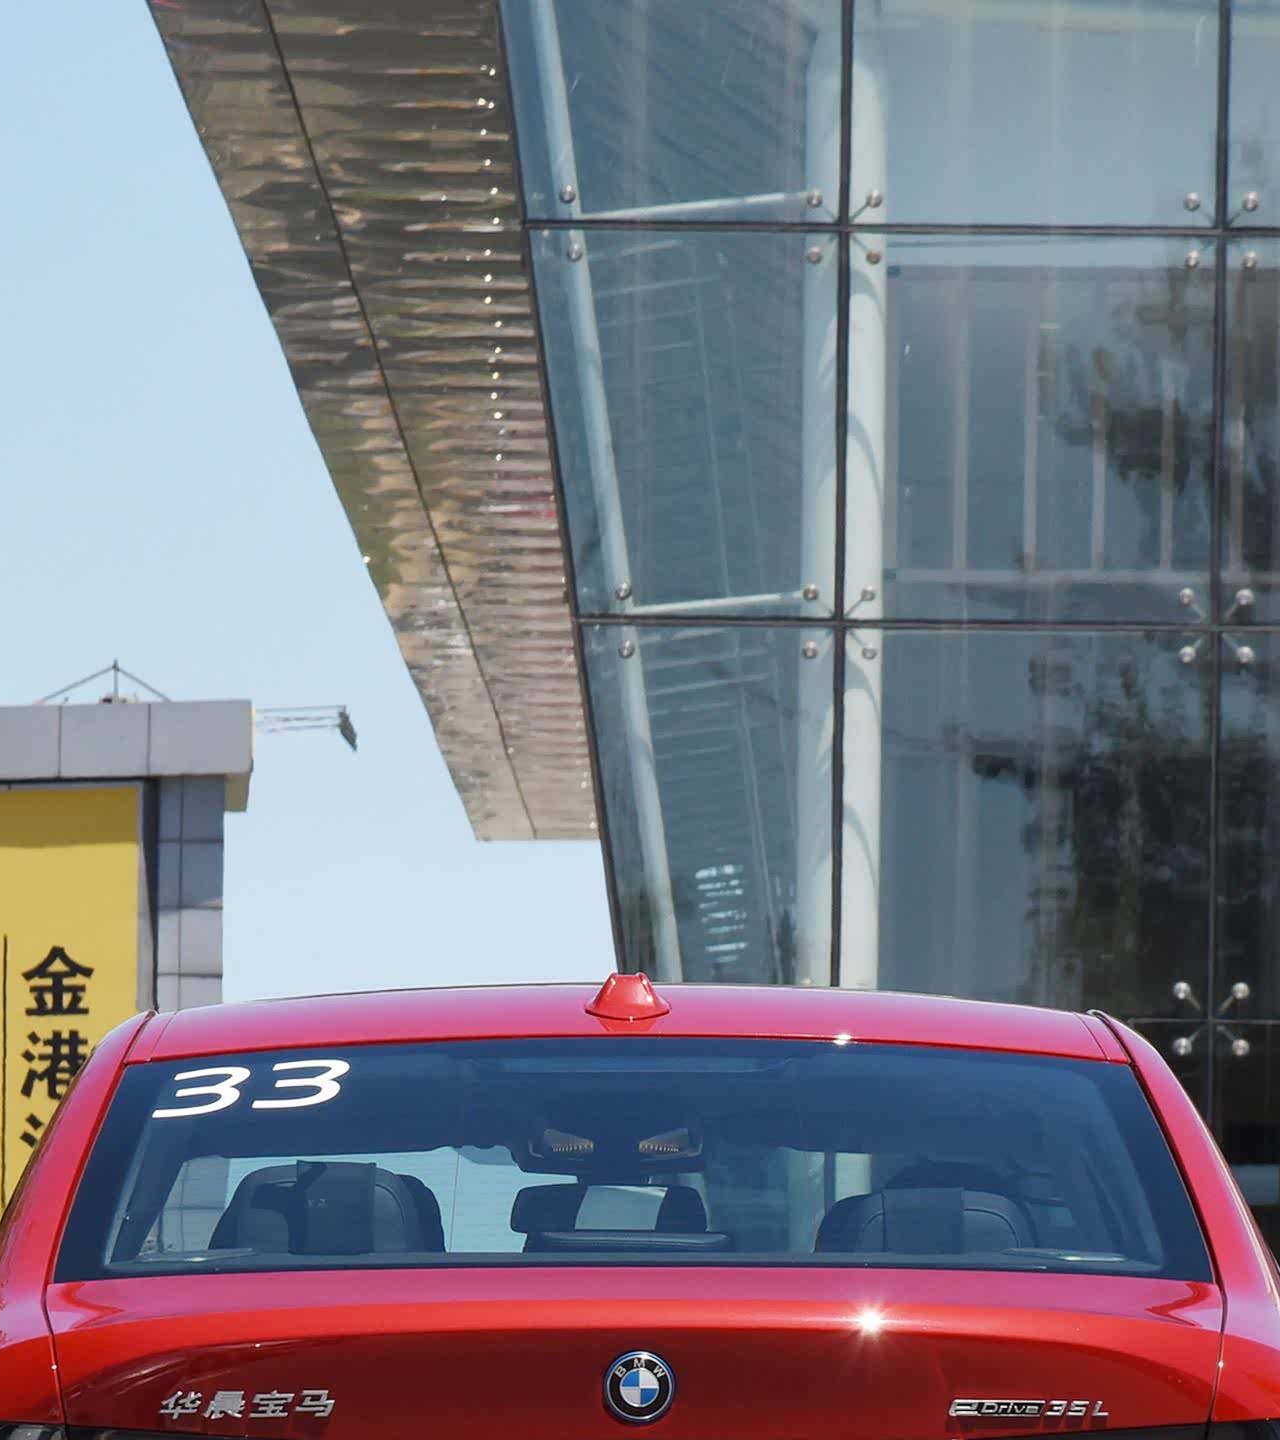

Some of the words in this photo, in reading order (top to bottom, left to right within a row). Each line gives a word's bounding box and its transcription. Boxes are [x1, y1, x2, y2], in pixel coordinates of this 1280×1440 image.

[20, 946, 94, 1148] 金港
[151, 1059, 351, 1119] 33
[614, 1358, 666, 1378] BMW
[159, 1389, 336, 1420] 华晨宝马
